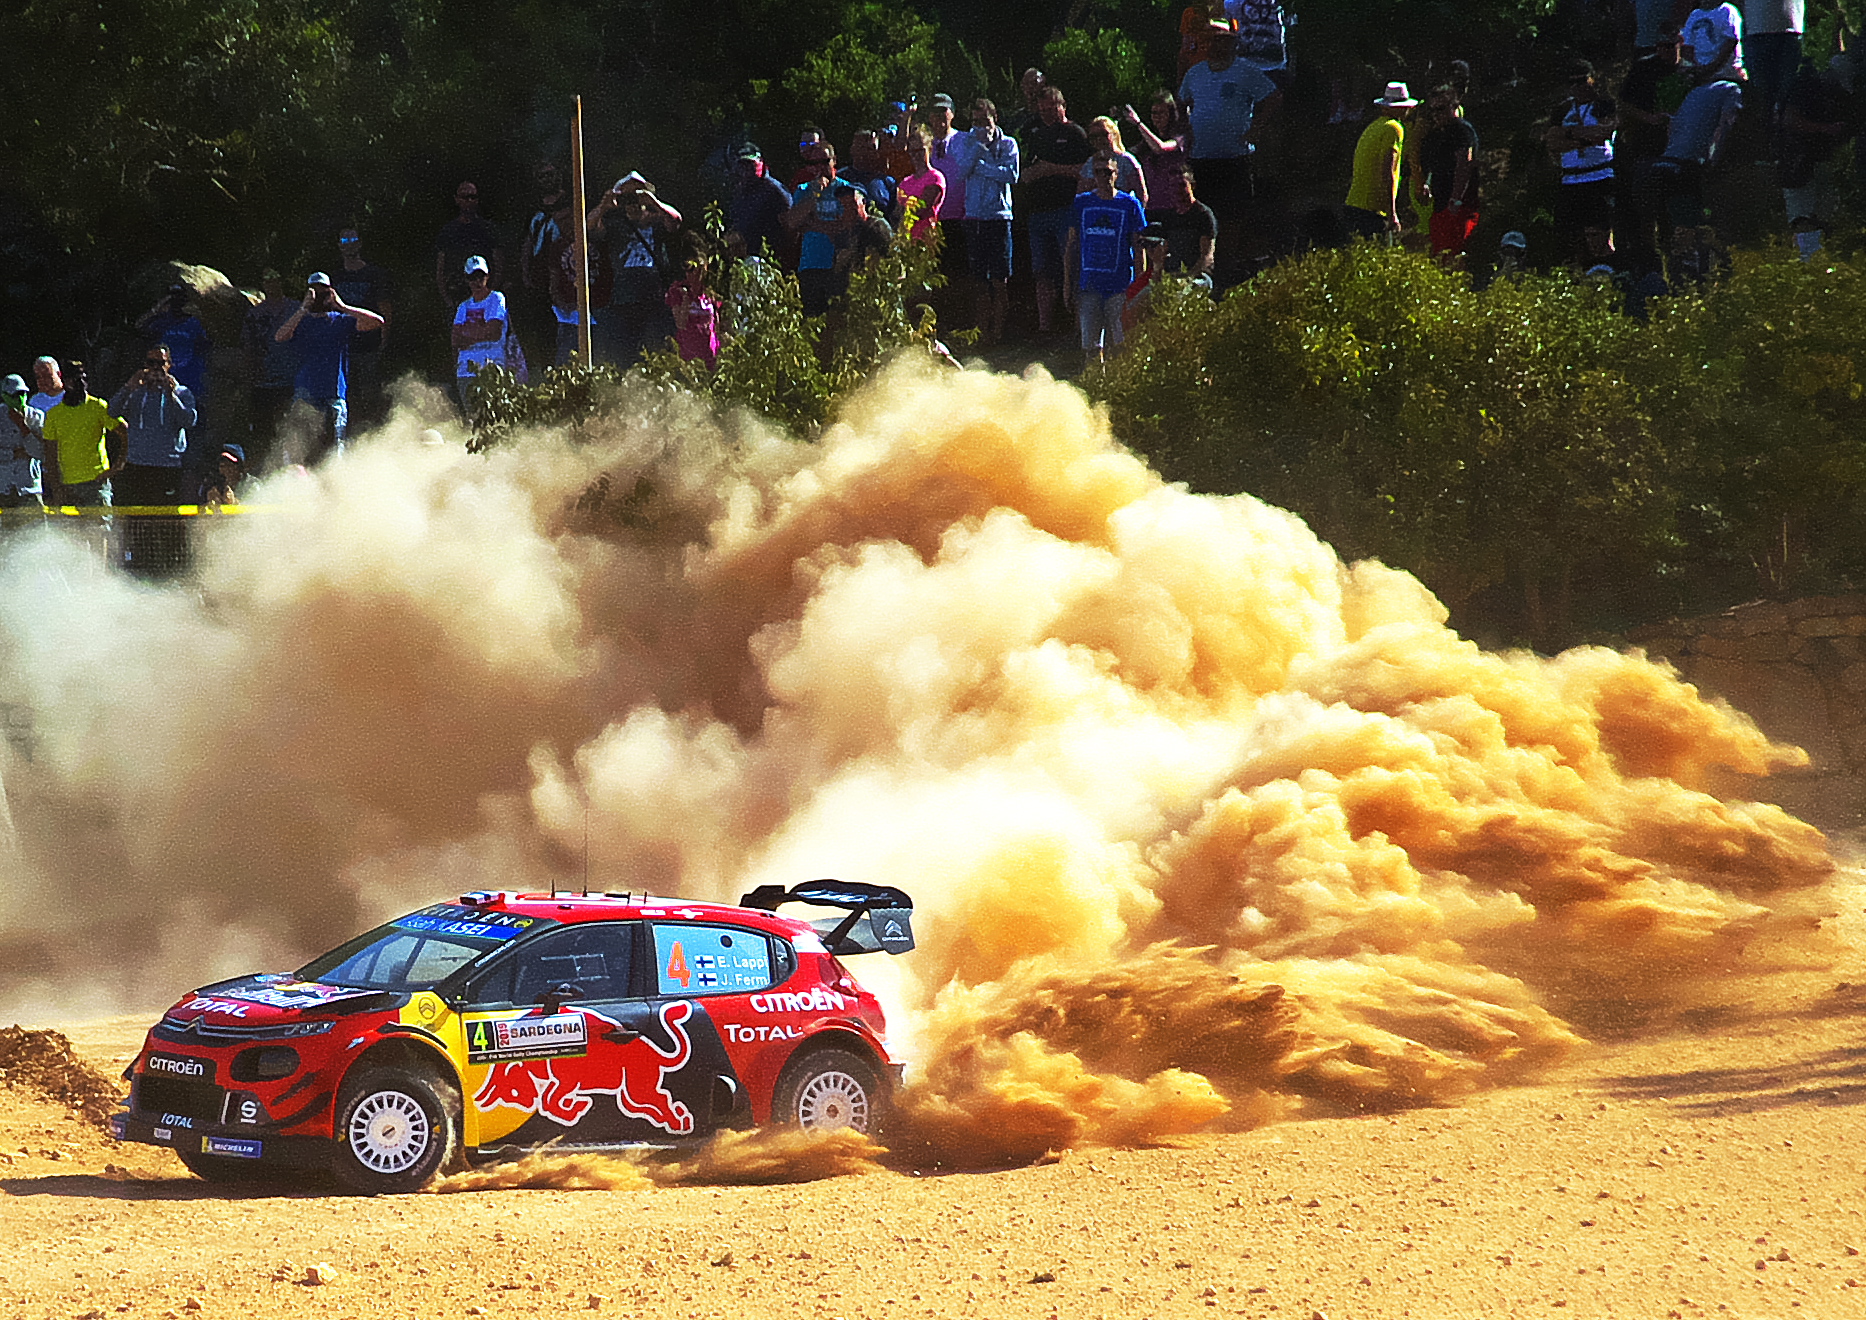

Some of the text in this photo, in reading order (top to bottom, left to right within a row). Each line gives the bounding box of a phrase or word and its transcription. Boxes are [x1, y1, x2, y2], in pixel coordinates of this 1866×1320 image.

[667, 941, 692, 988] 4
[717, 955, 769, 970] E. Lappi
[721, 973, 733, 986] J.
[181, 997, 250, 1018] TOTAL
[473, 1021, 582, 1051] 4 2019 SARDEGNA
[723, 1023, 804, 1043] TOTAL
[160, 1112, 193, 1129] TOTAL
